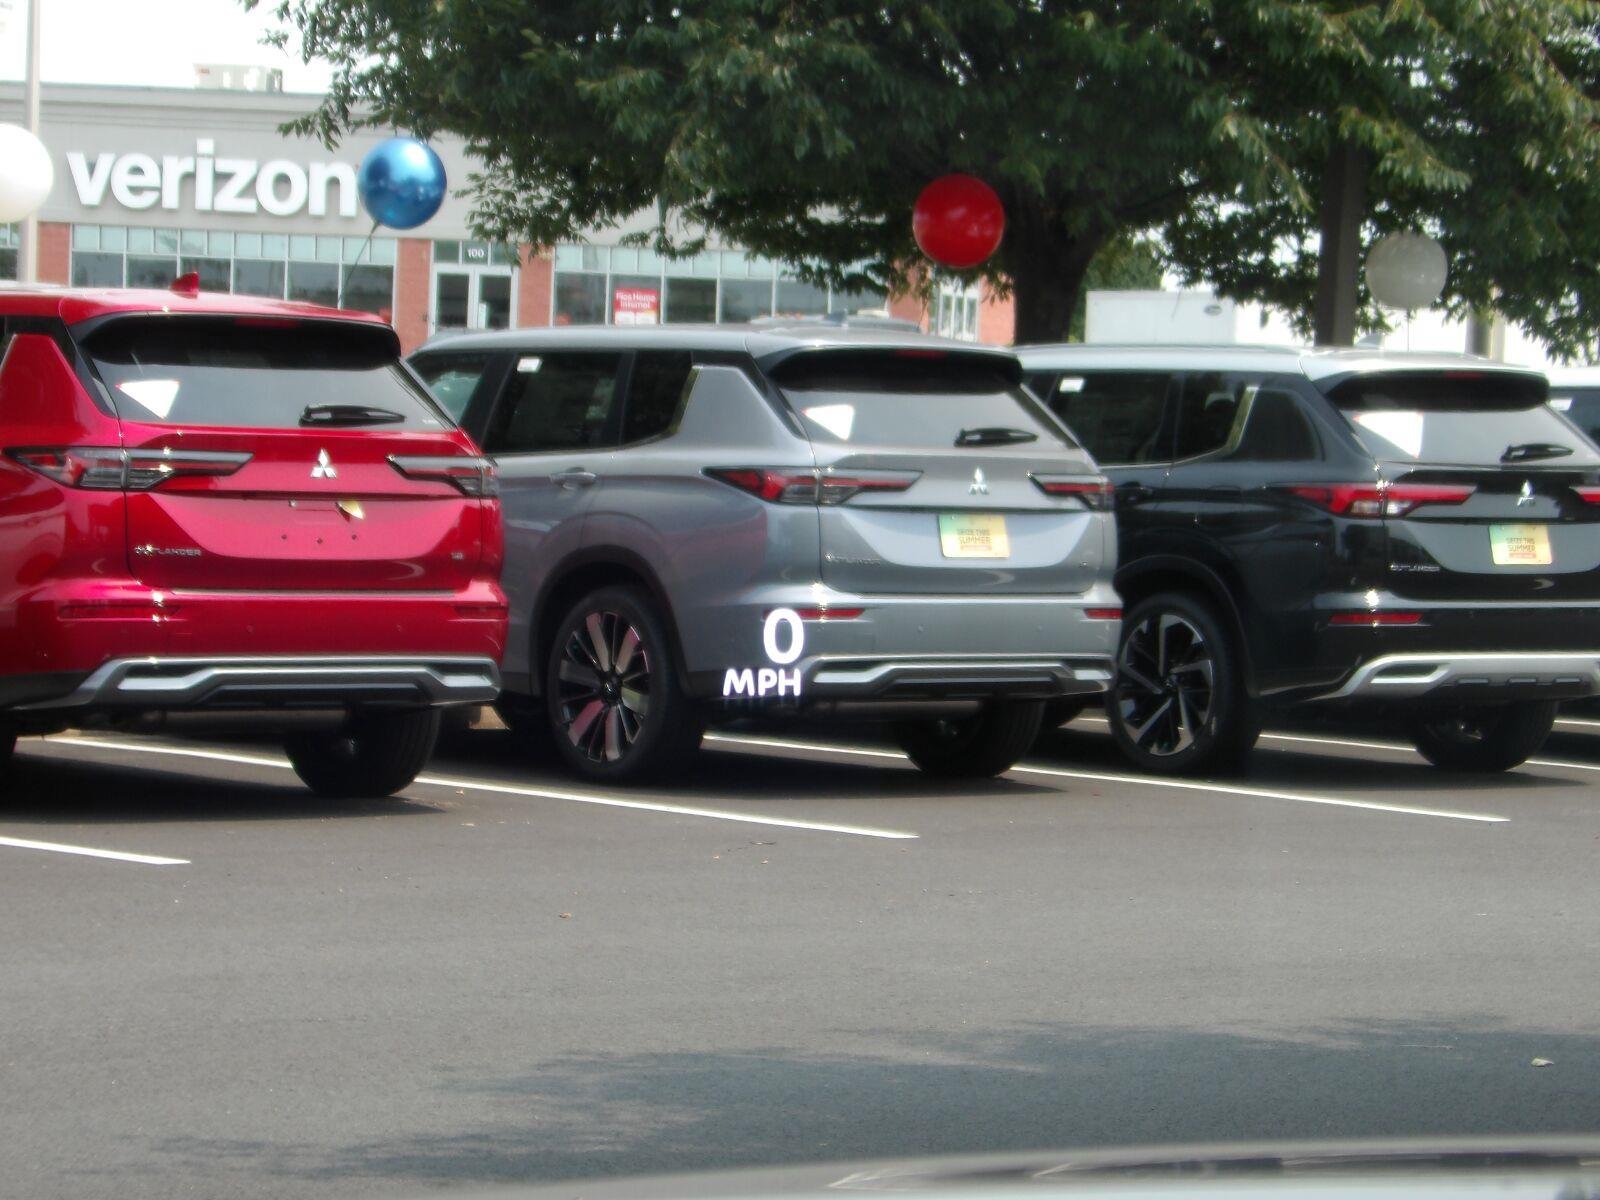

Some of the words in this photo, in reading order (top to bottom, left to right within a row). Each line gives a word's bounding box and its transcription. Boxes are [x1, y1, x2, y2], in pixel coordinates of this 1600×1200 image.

[66, 138, 358, 218] verizon
[467, 248, 485, 258] 100
[960, 536, 992, 545] SUMMER
[1507, 544, 1536, 552] SUMMER
[763, 607, 804, 664] 0
[722, 668, 801, 697] MPH
